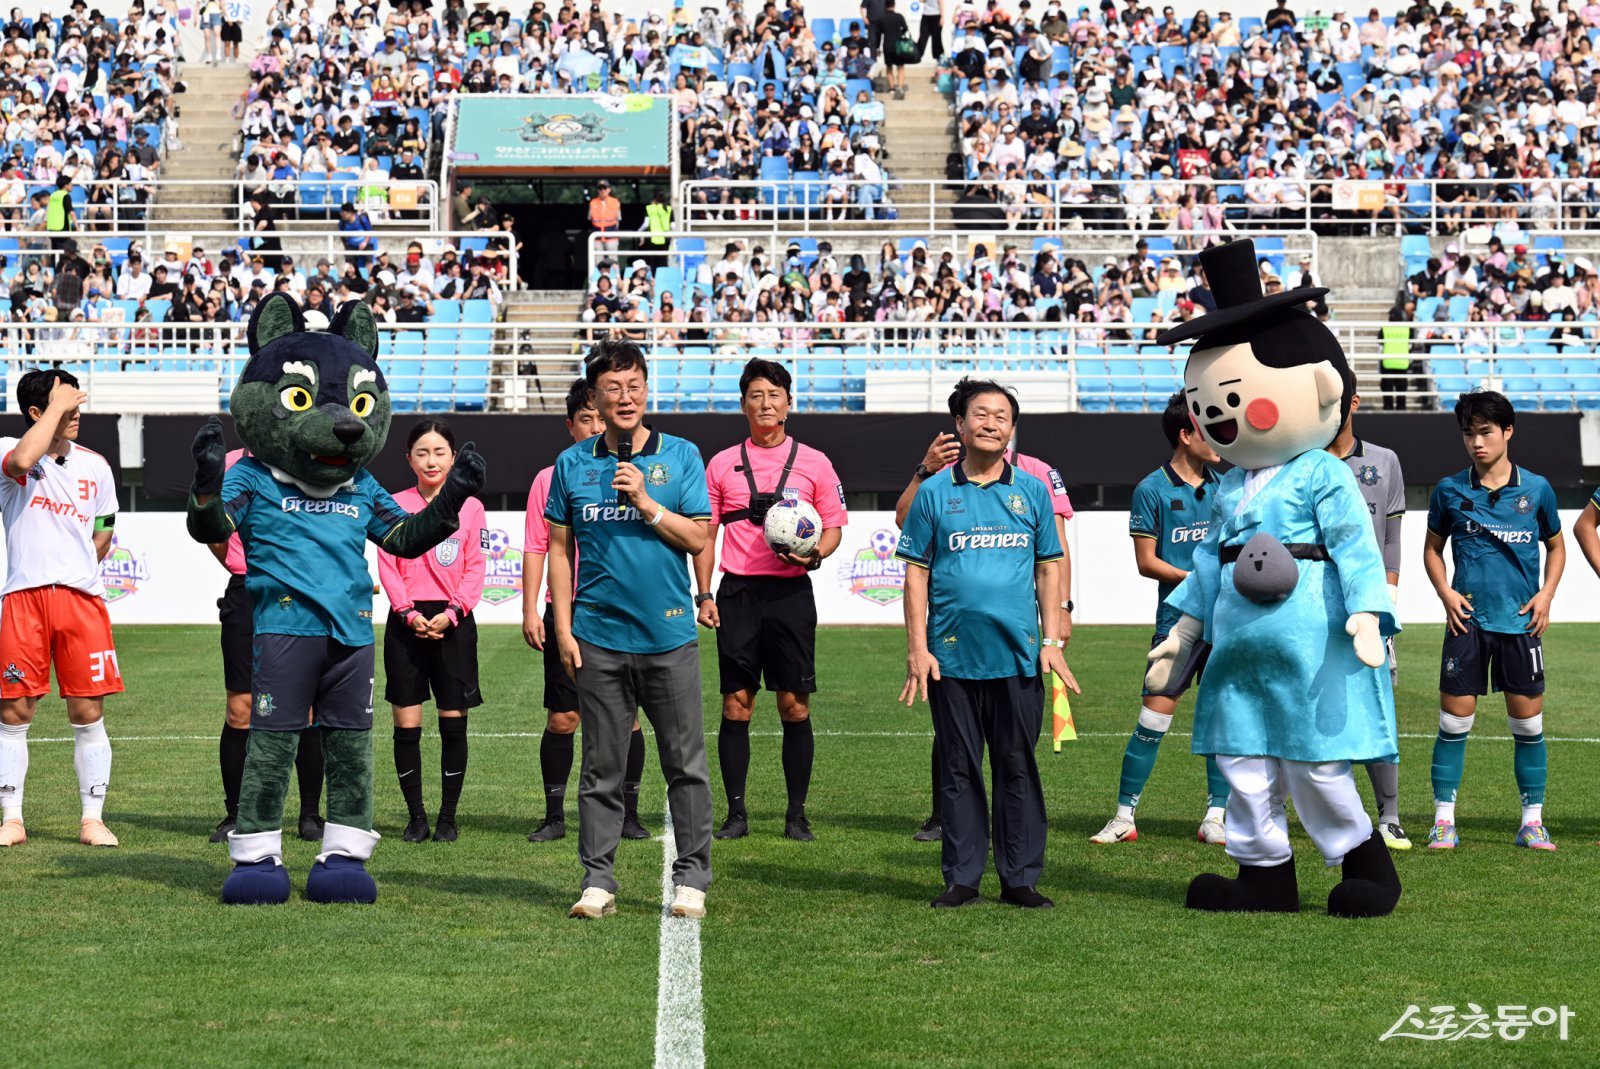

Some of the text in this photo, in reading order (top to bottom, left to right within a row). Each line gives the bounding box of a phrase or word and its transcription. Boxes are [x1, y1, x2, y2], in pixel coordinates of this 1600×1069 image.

[78, 480, 98, 500] 37
[281, 496, 359, 519] Greeners
[949, 531, 1029, 552] Greeners
[1171, 526, 1209, 544] Gree
[89, 649, 120, 682] 37
